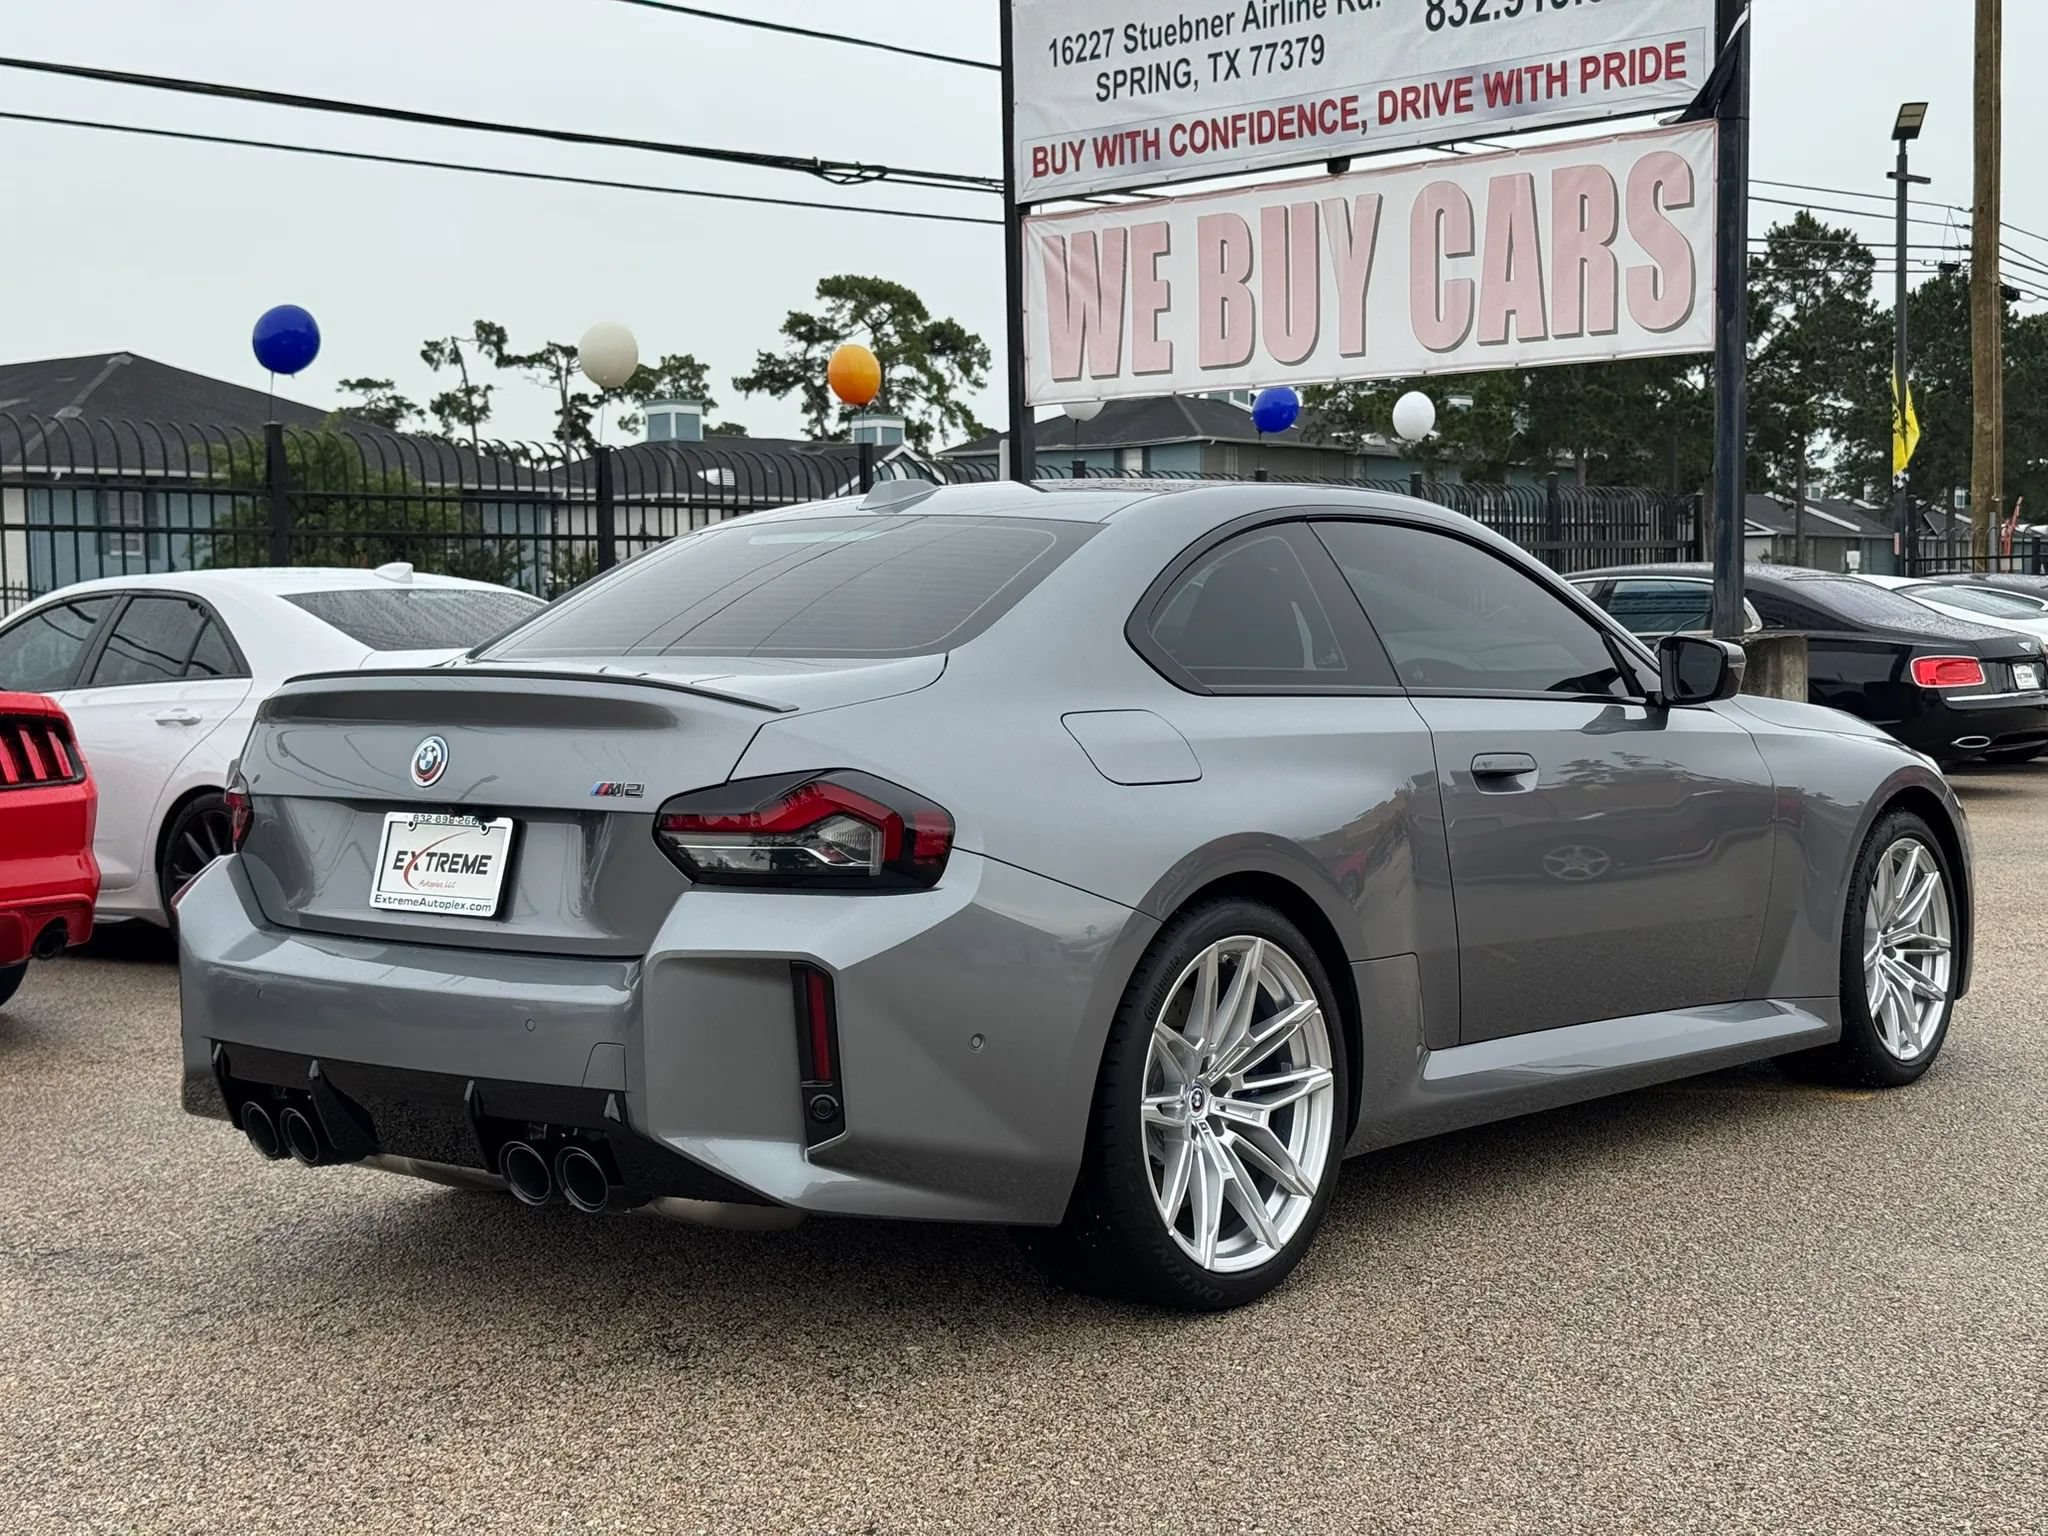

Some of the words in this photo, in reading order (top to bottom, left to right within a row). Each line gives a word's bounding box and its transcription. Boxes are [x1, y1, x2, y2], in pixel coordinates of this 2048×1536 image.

[1048, 27, 1115, 68] 16227
[1123, 12, 1236, 54] Stuebner
[1240, 0, 1327, 33] Airline
[1095, 57, 1199, 102] SPRING,
[1207, 48, 1241, 83] TX
[1249, 34, 1325, 76] 77379
[1031, 141, 1087, 179] BUY
[1093, 129, 1162, 171] WITH
[1168, 94, 1368, 155] CONFIDENCE,
[1377, 74, 1474, 125] DRIVE
[1482, 60, 1569, 109] WITH
[1579, 40, 1688, 94] PRIDE
[1043, 220, 1174, 383] WE
[1197, 193, 1383, 370] BUY
[1409, 151, 1696, 353] CARS
[592, 781, 645, 798] M2
[392, 850, 493, 875] EXTREME
[373, 894, 492, 912] ExtremeAutoplex.com
